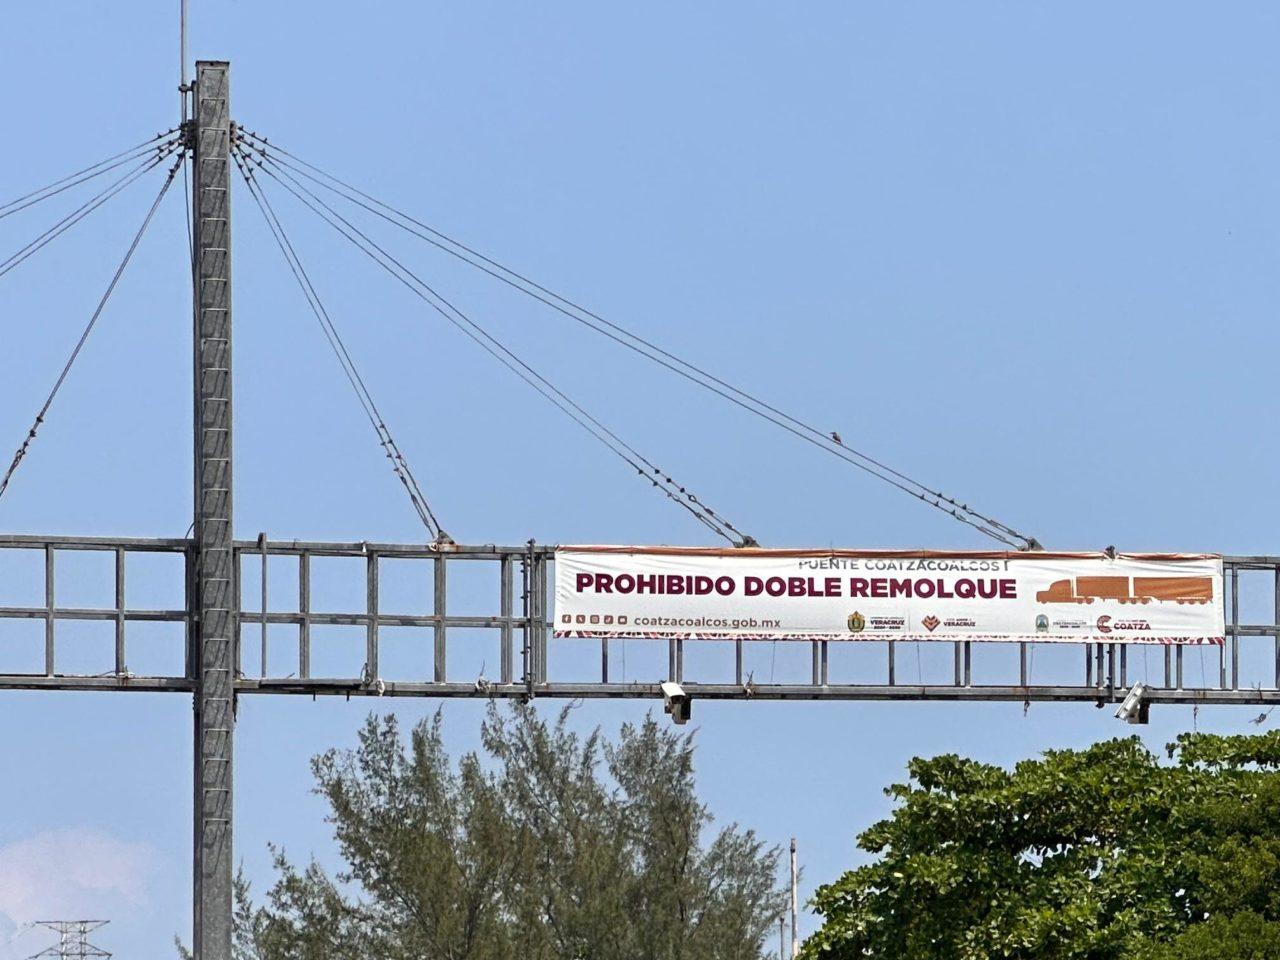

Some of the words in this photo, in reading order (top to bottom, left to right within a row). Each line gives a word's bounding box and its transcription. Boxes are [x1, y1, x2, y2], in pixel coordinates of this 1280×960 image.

[798, 559, 860, 570] PUENTE
[576, 572, 736, 597] PROHIBIDO
[744, 576, 842, 597] DOBLE
[850, 577, 1017, 599] REMOLQUE
[634, 617, 781, 629] coatzacoalcos.gob.mx
[1113, 623, 1151, 631] COATZA
